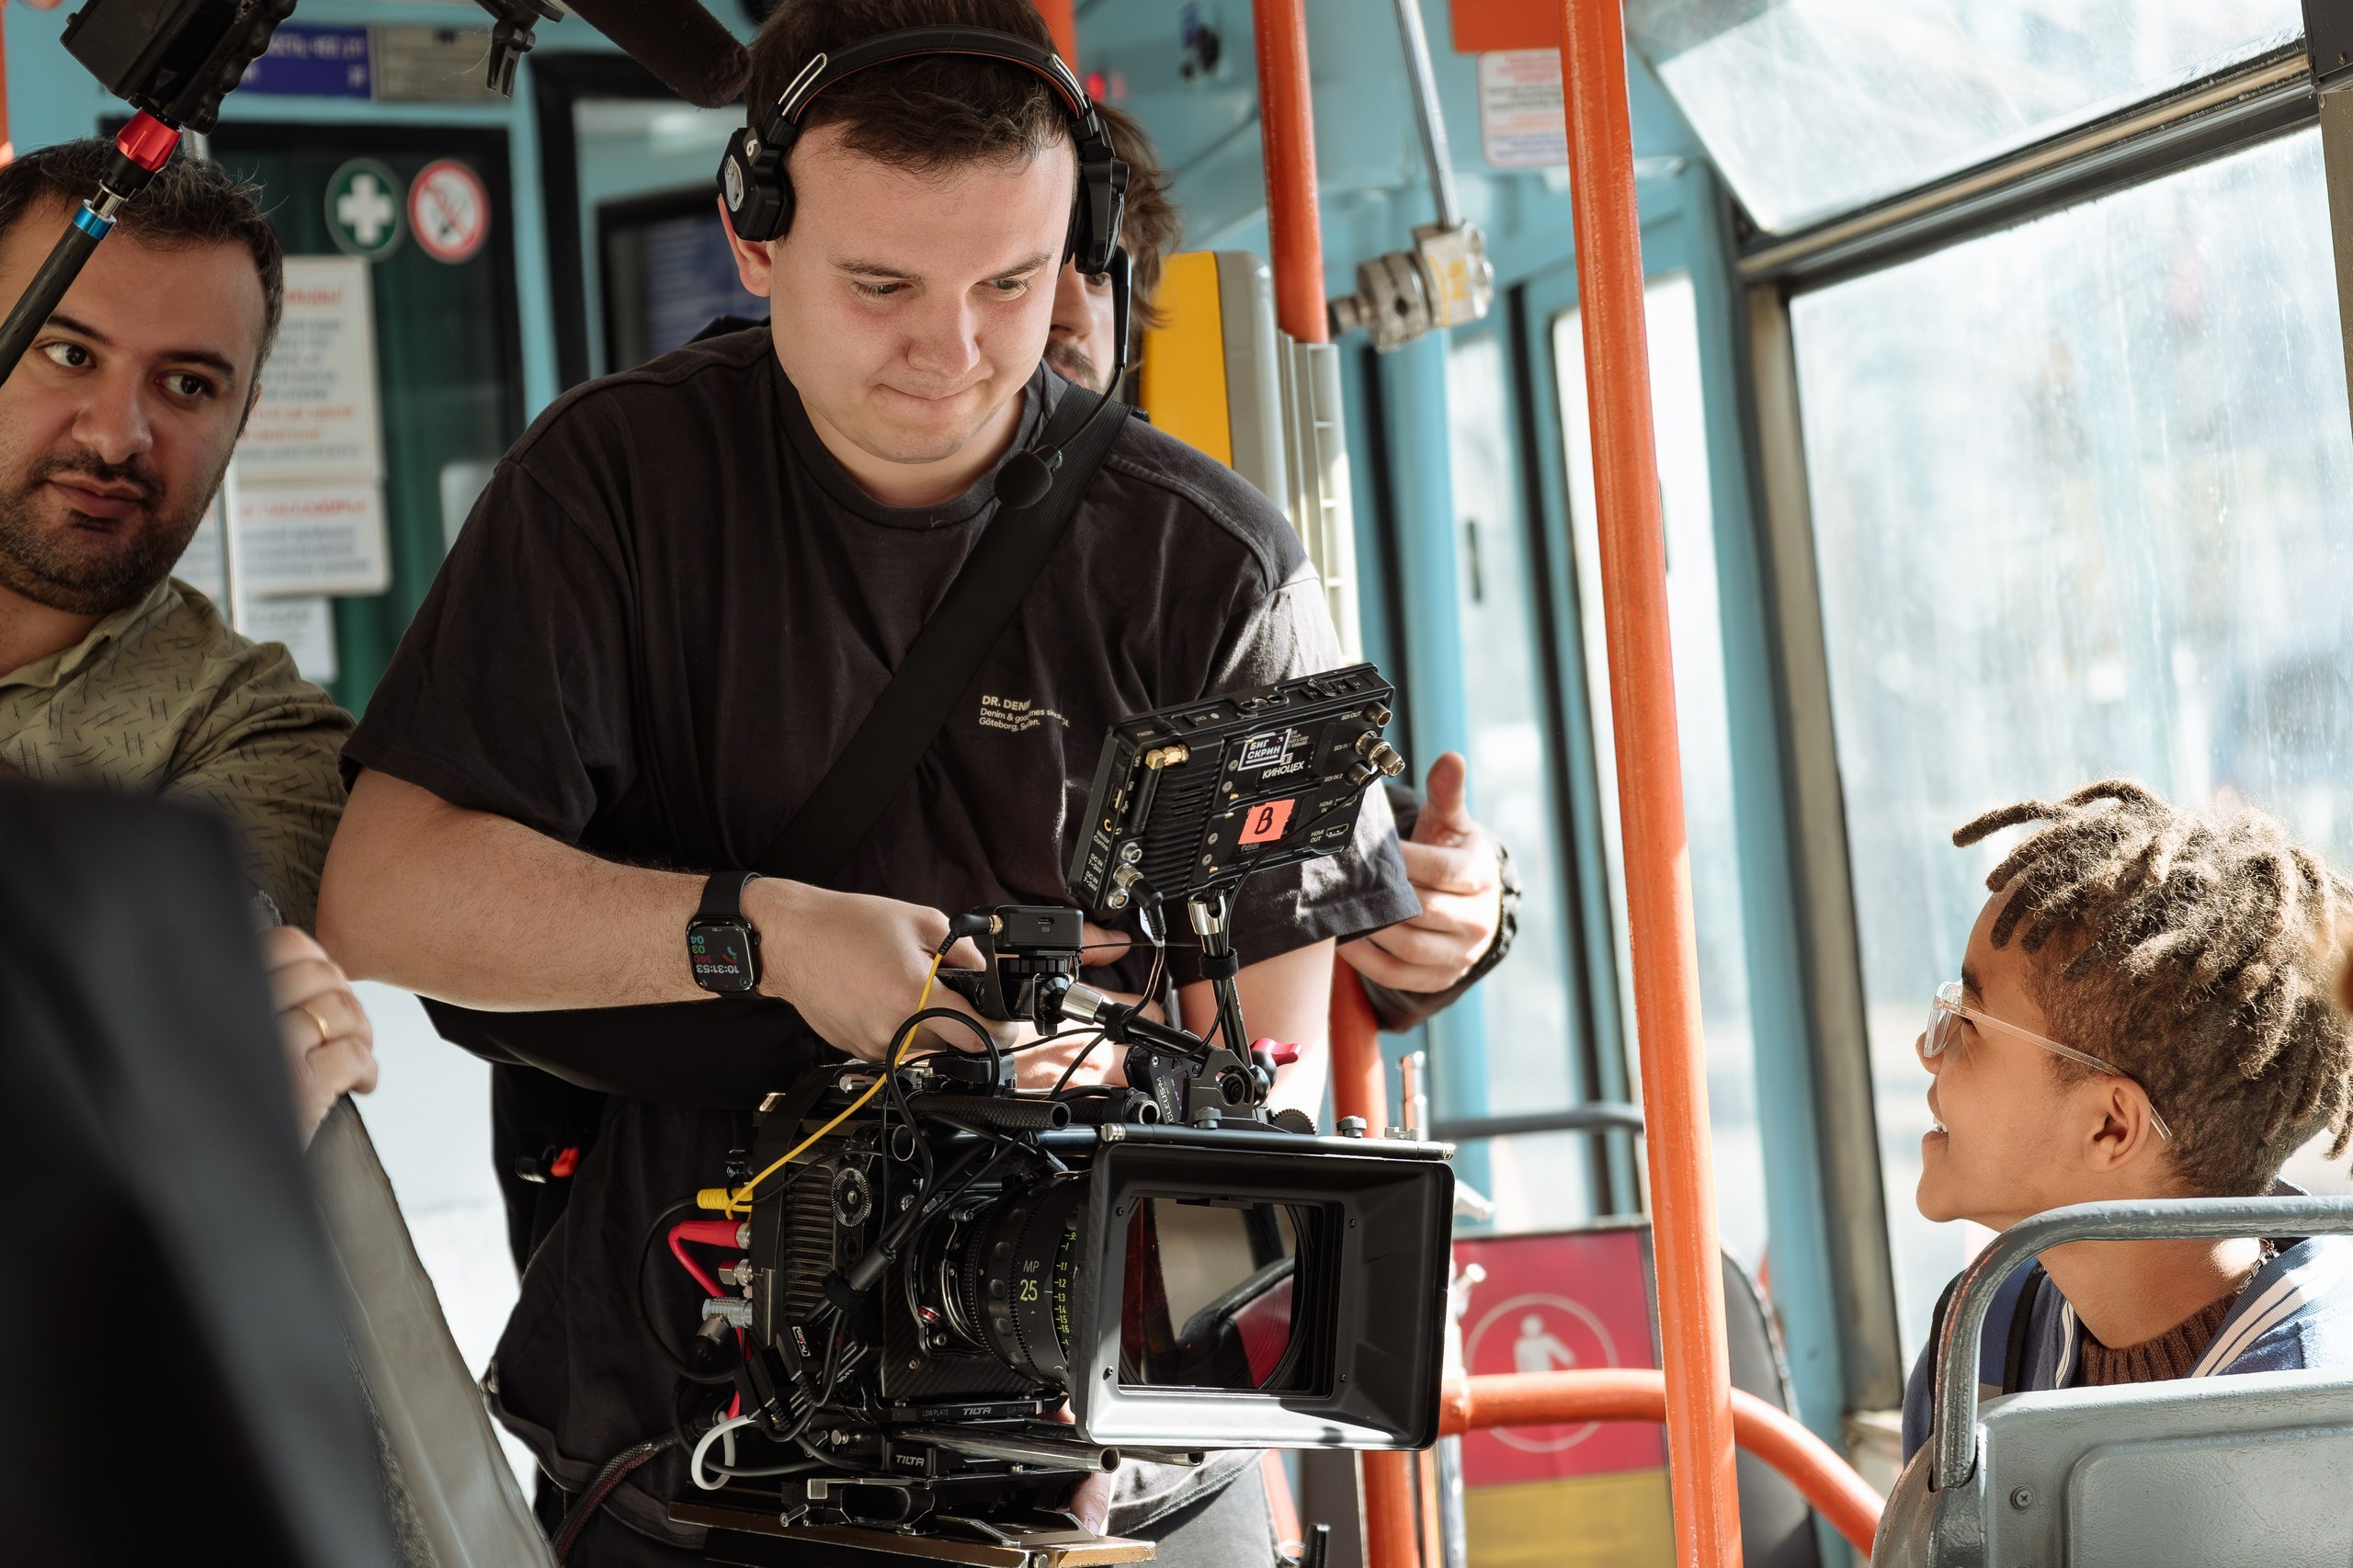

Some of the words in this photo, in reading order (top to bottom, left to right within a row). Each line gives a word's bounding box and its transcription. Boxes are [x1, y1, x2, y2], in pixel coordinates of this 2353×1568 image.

[982, 695, 1001, 707] DR.
[1003, 699, 1031, 711] DENI
[980, 708, 1006, 720] Denim
[1006, 712, 1014, 722] &
[1249, 739, 1269, 751] БИГ
[1246, 745, 1281, 760] СКРИН
[1261, 760, 1305, 779] КИНОЦЕХ
[1254, 806, 1274, 835] B
[1097, 829, 1110, 845] Motor
[1310, 829, 1325, 837] HDMI
[1310, 835, 1323, 844] OUT
[1090, 853, 1098, 863] DC
[1086, 870, 1094, 881] DC
[690, 936, 705, 945] 04
[691, 945, 706, 954] 03
[696, 964, 740, 974] 10:31:53
[1023, 1260, 1040, 1273] MP
[1019, 1278, 1039, 1301] 25
[962, 1406, 992, 1415] TILTA
[895, 1454, 925, 1467] TILTA
